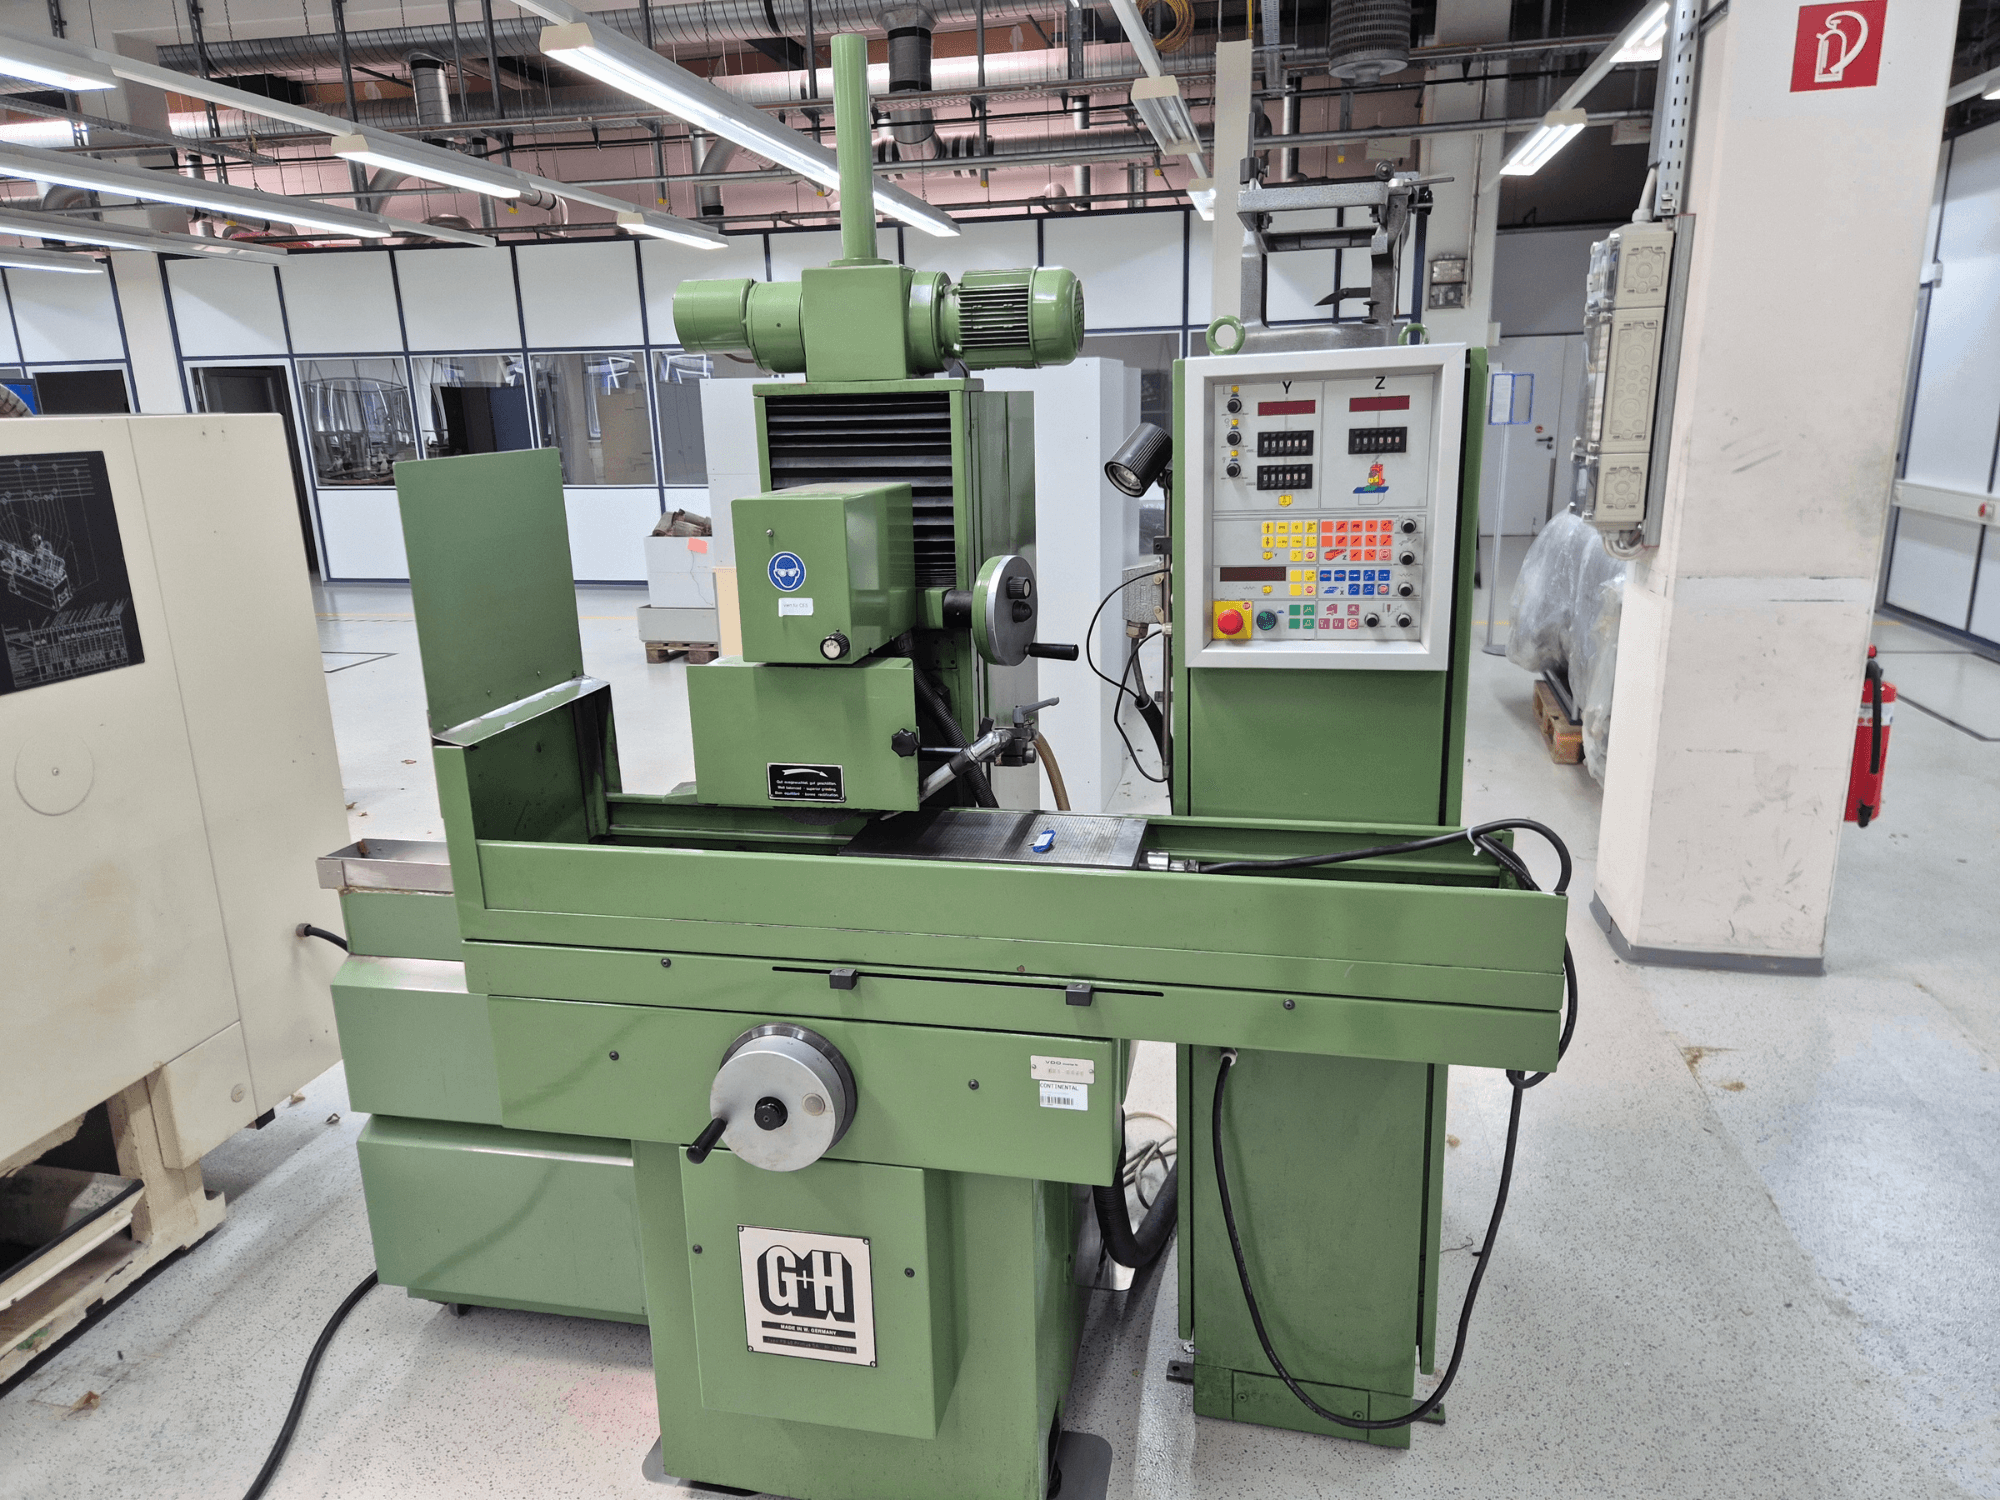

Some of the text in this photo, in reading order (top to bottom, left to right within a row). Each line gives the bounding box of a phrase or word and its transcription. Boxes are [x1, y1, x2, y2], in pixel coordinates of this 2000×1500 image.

[1282, 380, 1292, 394] Y
[1374, 376, 1385, 390] Z
[1040, 1083, 1079, 1091] CONTINENTAL
[757, 1245, 855, 1323] G+H
[810, 1327, 837, 1336] GERMANY
